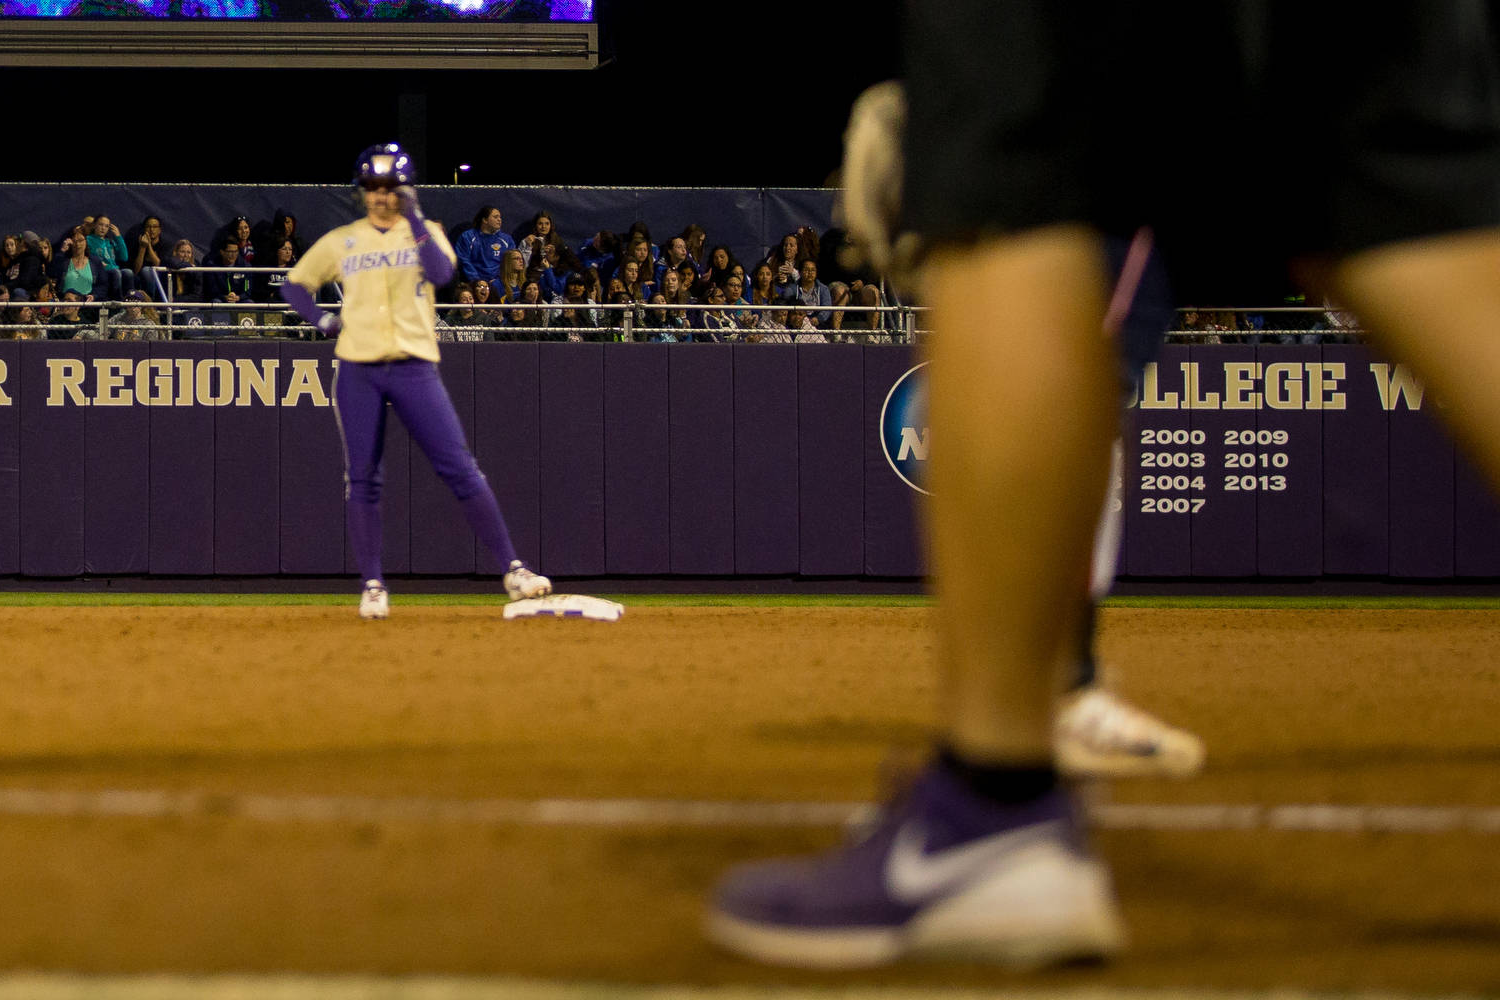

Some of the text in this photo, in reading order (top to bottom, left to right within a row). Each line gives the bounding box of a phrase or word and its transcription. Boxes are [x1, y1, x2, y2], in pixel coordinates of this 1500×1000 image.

[343, 246, 421, 276] HUSKIE
[46, 358, 337, 407] REGIONA
[1126, 362, 1347, 410] LLEGE
[1140, 429, 1289, 445] 2000 2009
[1140, 452, 1289, 468] 2003 2010
[1140, 475, 1287, 491] 2004 2013
[1140, 498, 1206, 513] 2007
